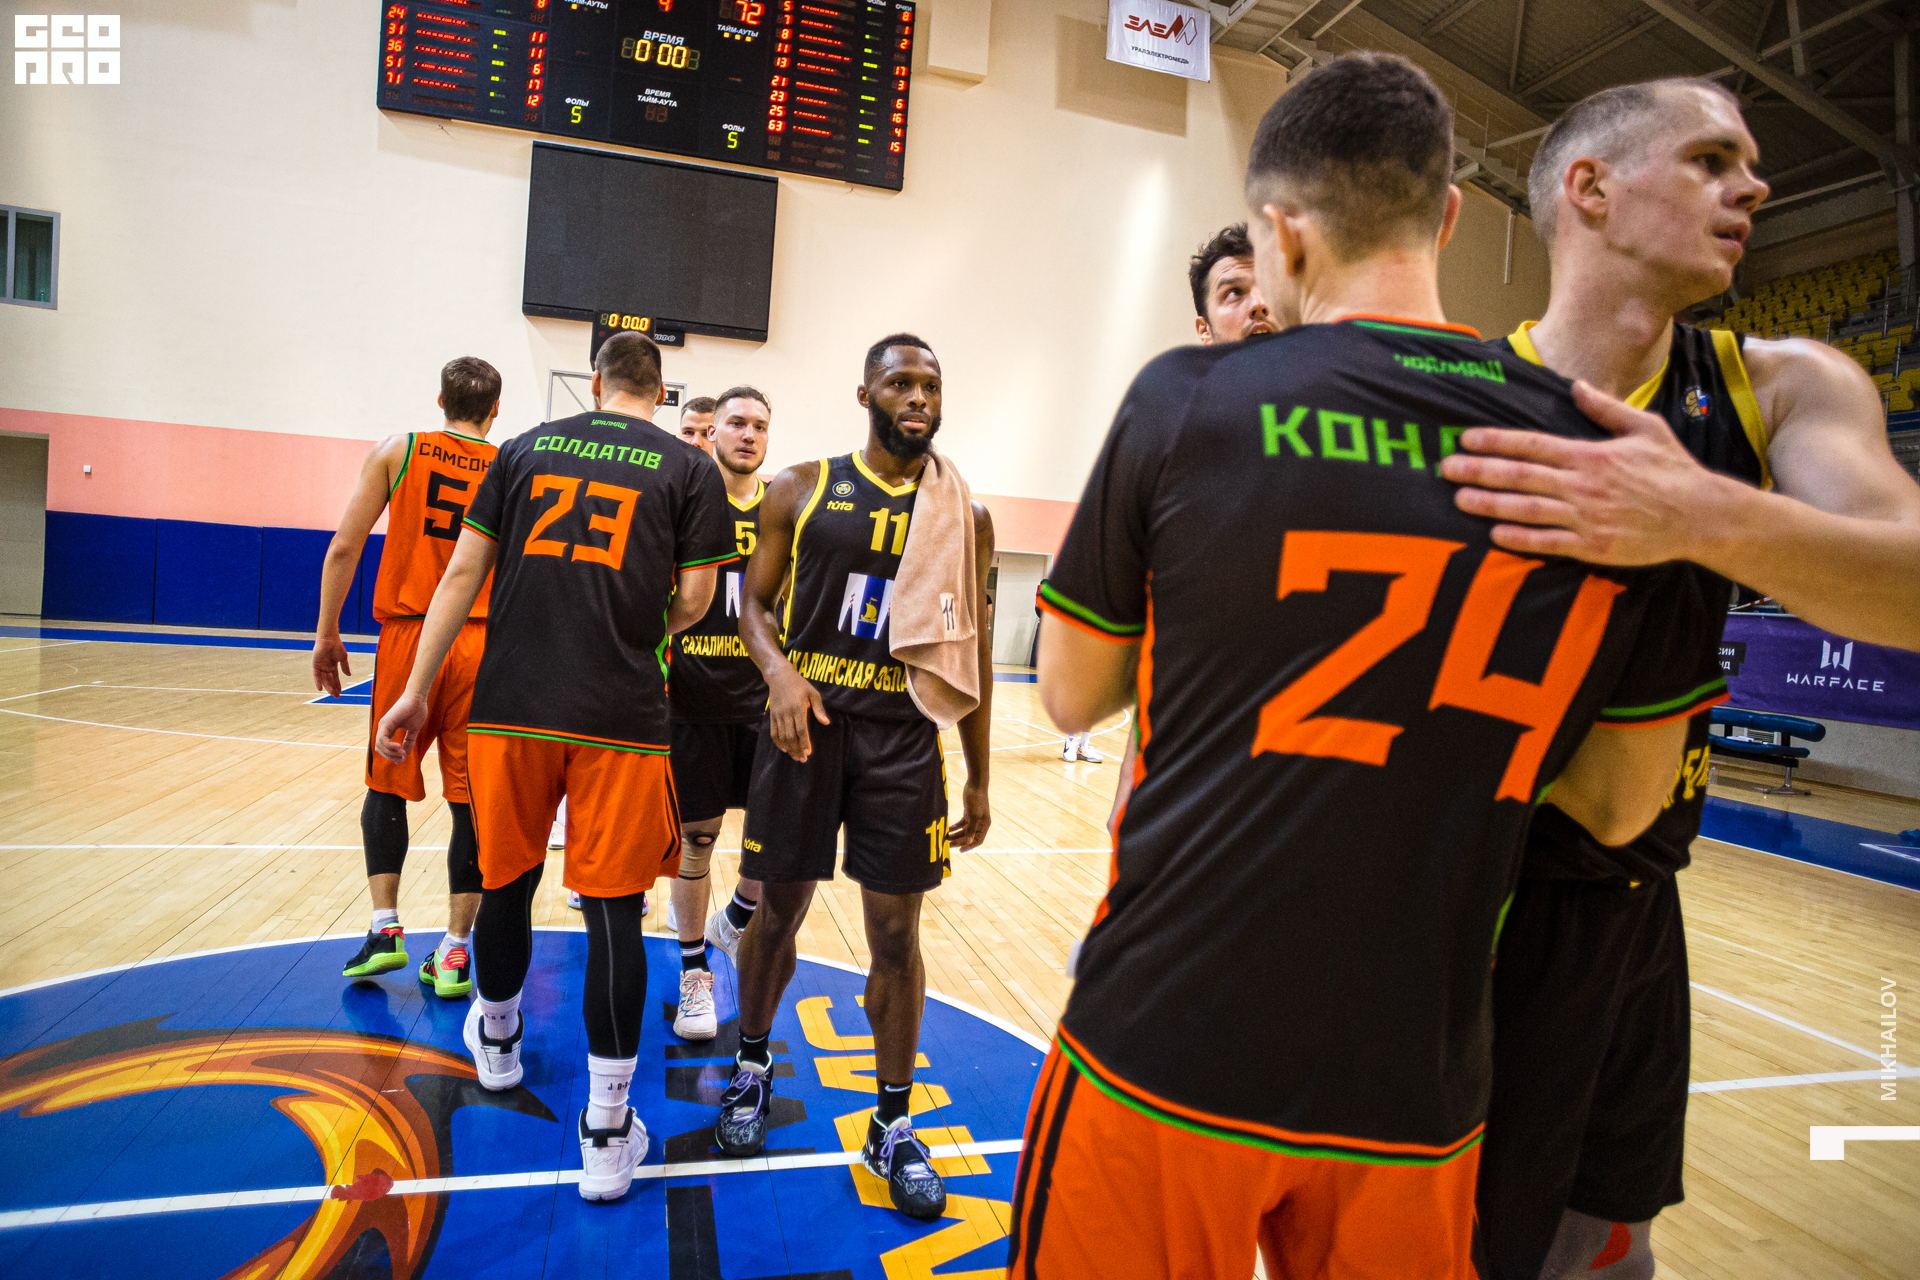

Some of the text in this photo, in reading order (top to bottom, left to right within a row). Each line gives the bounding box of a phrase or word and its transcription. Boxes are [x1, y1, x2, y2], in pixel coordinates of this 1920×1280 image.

[386, 4, 407, 19] 24
[736, 0, 764, 25] 72
[782, 0, 794, 12] 5
[783, 14, 794, 26] 7
[901, 10, 913, 22] 8
[387, 21, 406, 36] 31
[717, 24, 759, 38] ТАЙМ-АУТЫ
[780, 28, 793, 40] 8
[903, 25, 912, 36] 1
[386, 37, 405, 52] 36
[530, 31, 547, 44] 11
[643, 30, 685, 46] ВРЕМЯ
[899, 38, 911, 50] 2
[529, 47, 546, 59] 11
[776, 42, 792, 54] 11
[1131, 45, 1190, 64] УРАЛЭЛЕКТРОМЕДЬ
[385, 53, 405, 68] 51
[775, 57, 791, 69] 13
[531, 62, 544, 76] 6
[894, 65, 909, 77] 17
[385, 69, 404, 86] 71
[527, 78, 544, 91] 17
[770, 74, 790, 87] 21
[897, 79, 908, 91] 3
[644, 88, 671, 98] ВРЕМЯ
[769, 90, 788, 103] 23
[526, 93, 543, 108] 12
[565, 97, 589, 107] ФОЛЫ
[637, 95, 678, 107] ТАЙМ-АУТА
[894, 97, 906, 110] 6
[571, 105, 582, 123] 5
[768, 104, 786, 118] 25
[891, 112, 905, 125] 16
[722, 123, 745, 132] ФОЛЫ
[767, 119, 786, 133] 63
[893, 126, 904, 138] 4
[727, 131, 738, 149] 5
[889, 141, 903, 153] 15
[533, 435, 662, 470] СОЛДАТОВ
[423, 470, 481, 542] 5
[523, 474, 642, 571] 23
[735, 520, 757, 556] 5
[869, 507, 909, 556] 11
[943, 598, 955, 630] 11
[681, 635, 749, 657] САХАЛИНСК
[1251, 531, 1627, 803] 24
[1786, 673, 1885, 692] WARFACE
